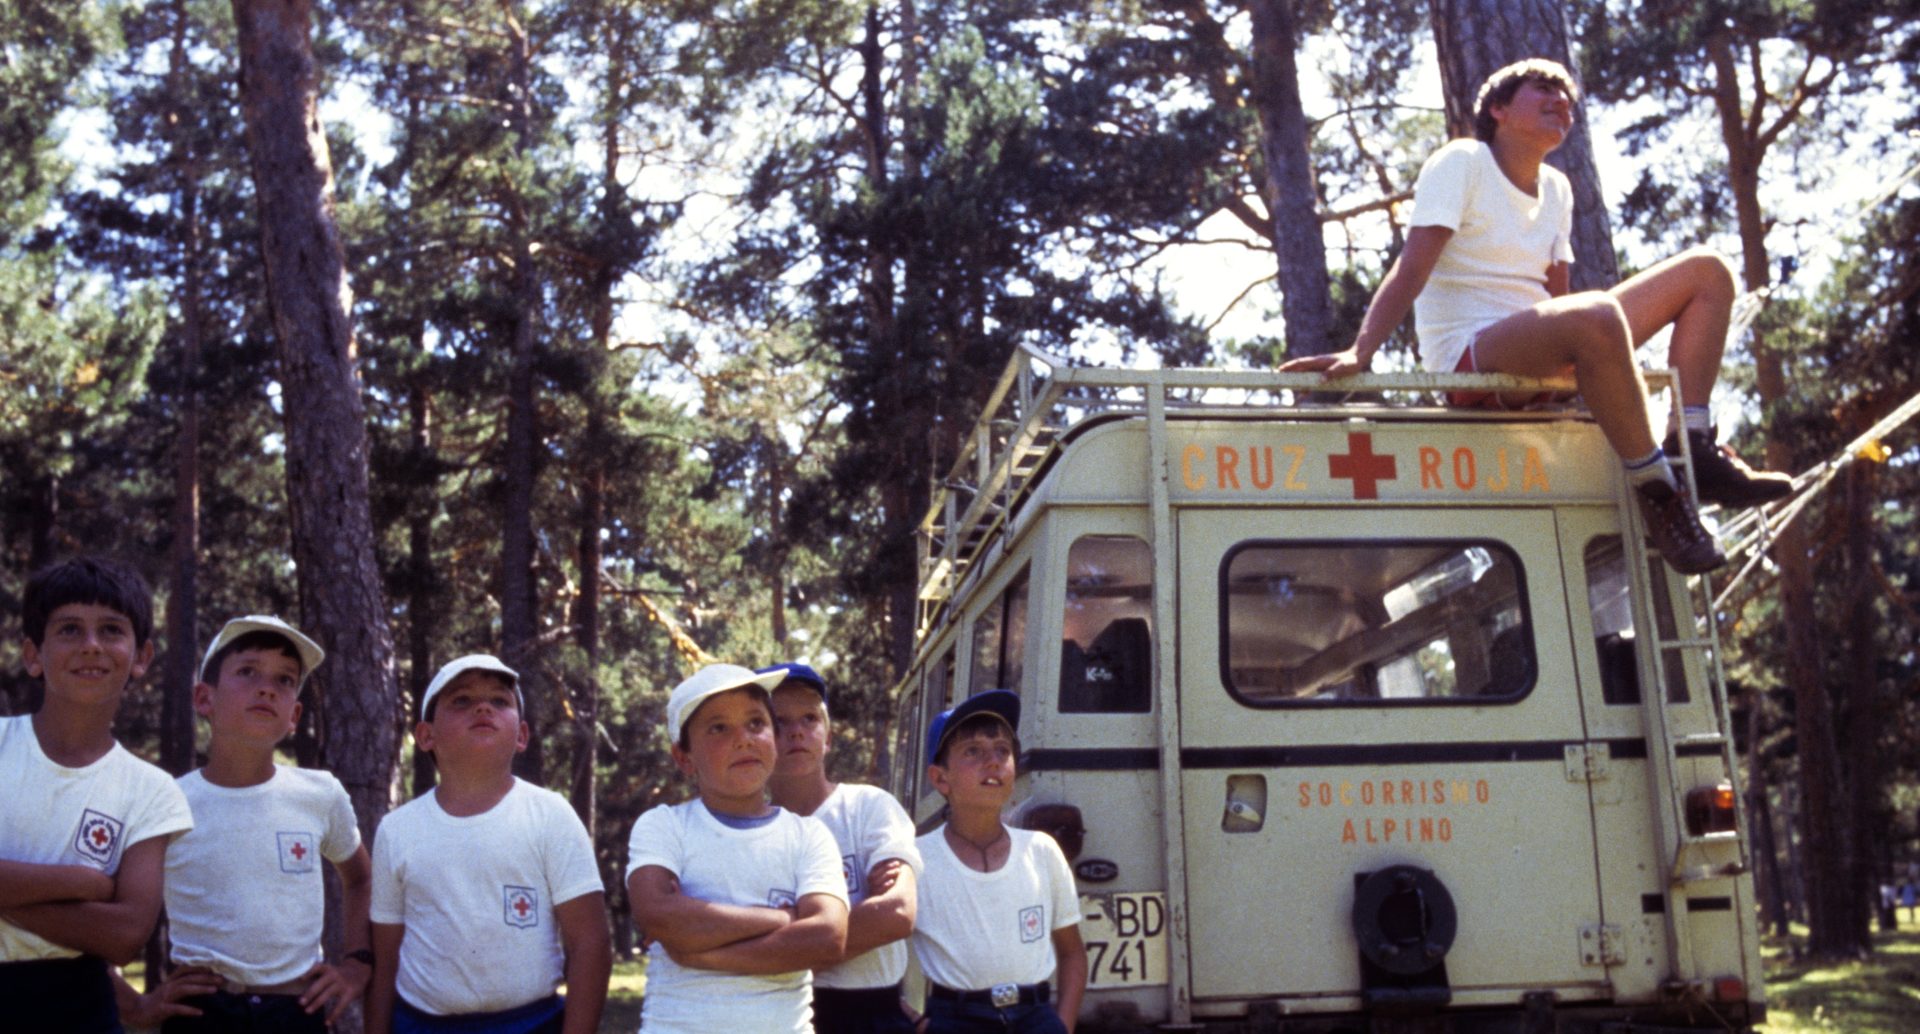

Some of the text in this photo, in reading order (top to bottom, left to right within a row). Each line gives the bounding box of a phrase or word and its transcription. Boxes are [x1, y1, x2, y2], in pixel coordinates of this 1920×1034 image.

[1180, 444, 1551, 492] CRUZ ROJA
[1298, 779, 1489, 808] SOCORRISMO
[1342, 817, 1453, 844] ALPINO
